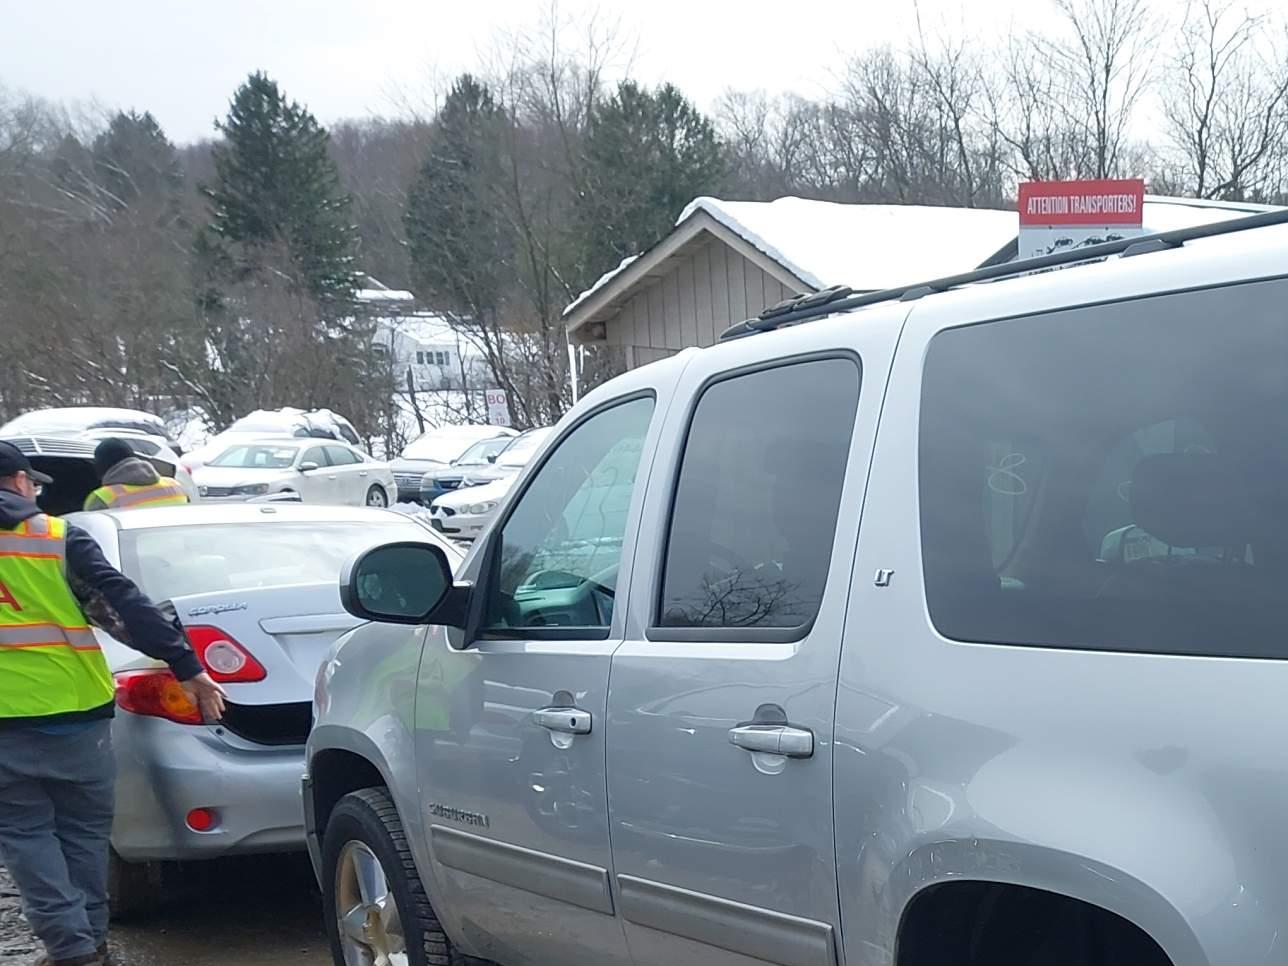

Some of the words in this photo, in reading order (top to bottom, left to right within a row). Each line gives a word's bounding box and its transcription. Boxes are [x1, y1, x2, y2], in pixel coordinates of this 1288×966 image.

[1027, 196, 1068, 214] ATTENTION
[1070, 194, 1137, 214] TRANSPORTERS!
[874, 569, 895, 587] LT
